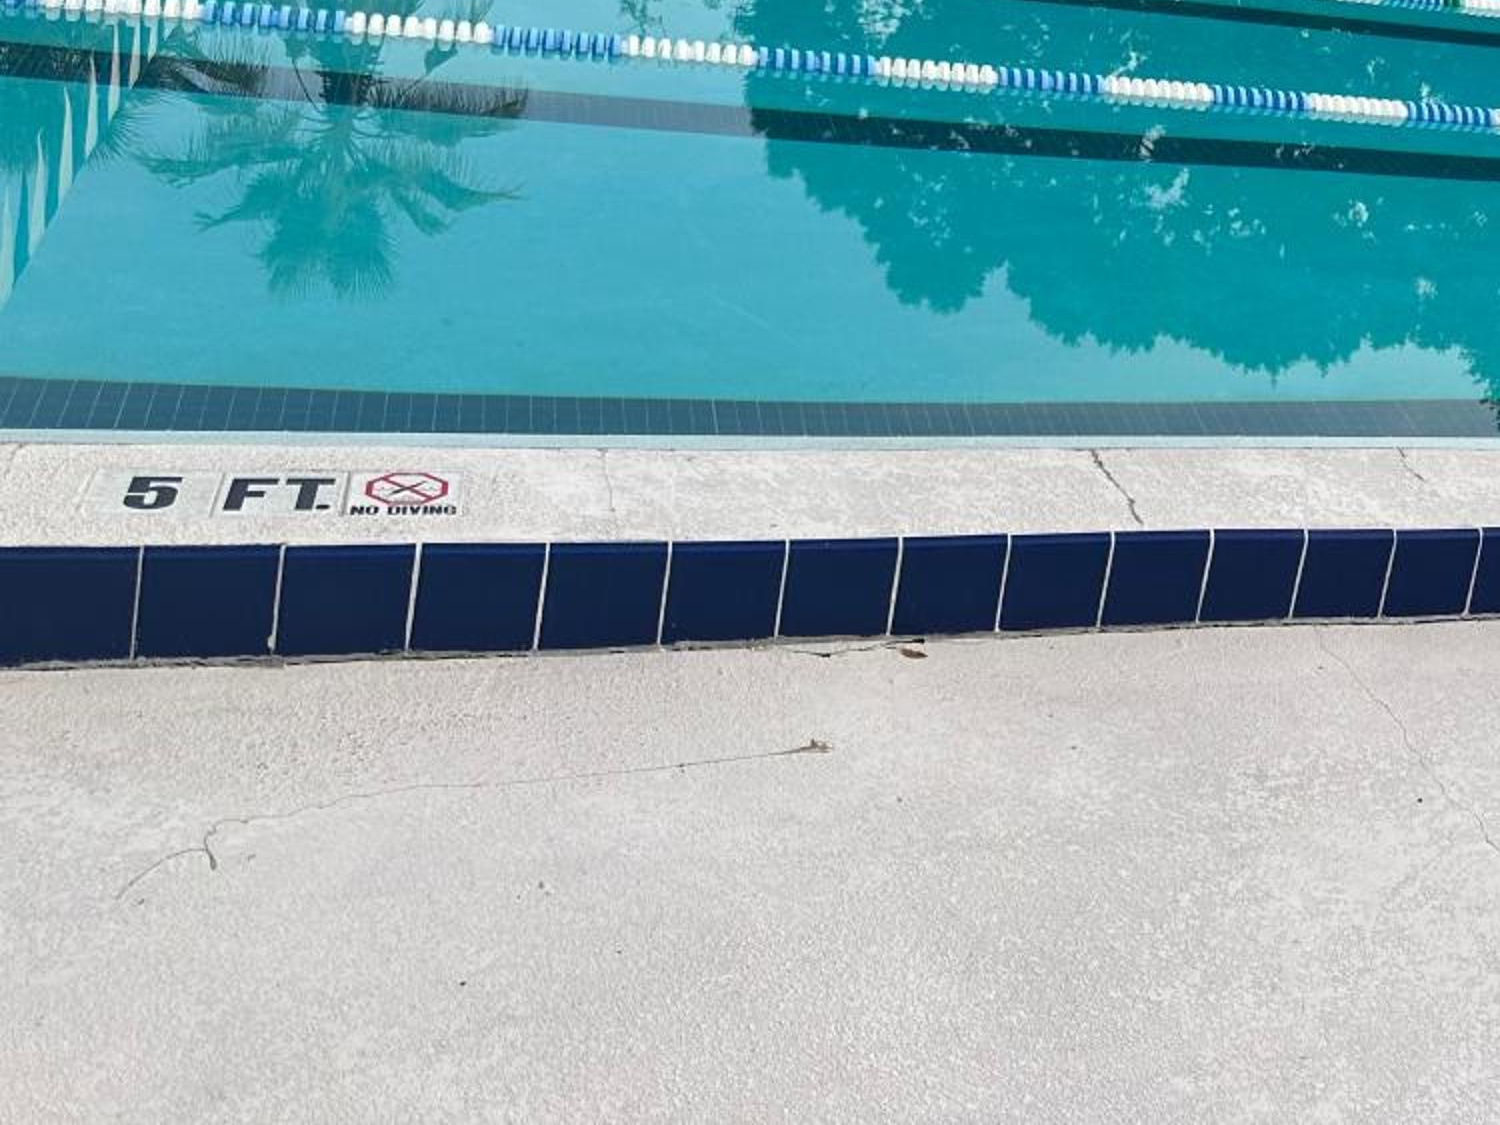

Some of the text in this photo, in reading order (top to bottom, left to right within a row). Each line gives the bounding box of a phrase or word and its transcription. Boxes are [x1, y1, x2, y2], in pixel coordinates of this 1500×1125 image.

[123, 477, 182, 510] 5
[350, 505, 457, 515] NO DIVING
